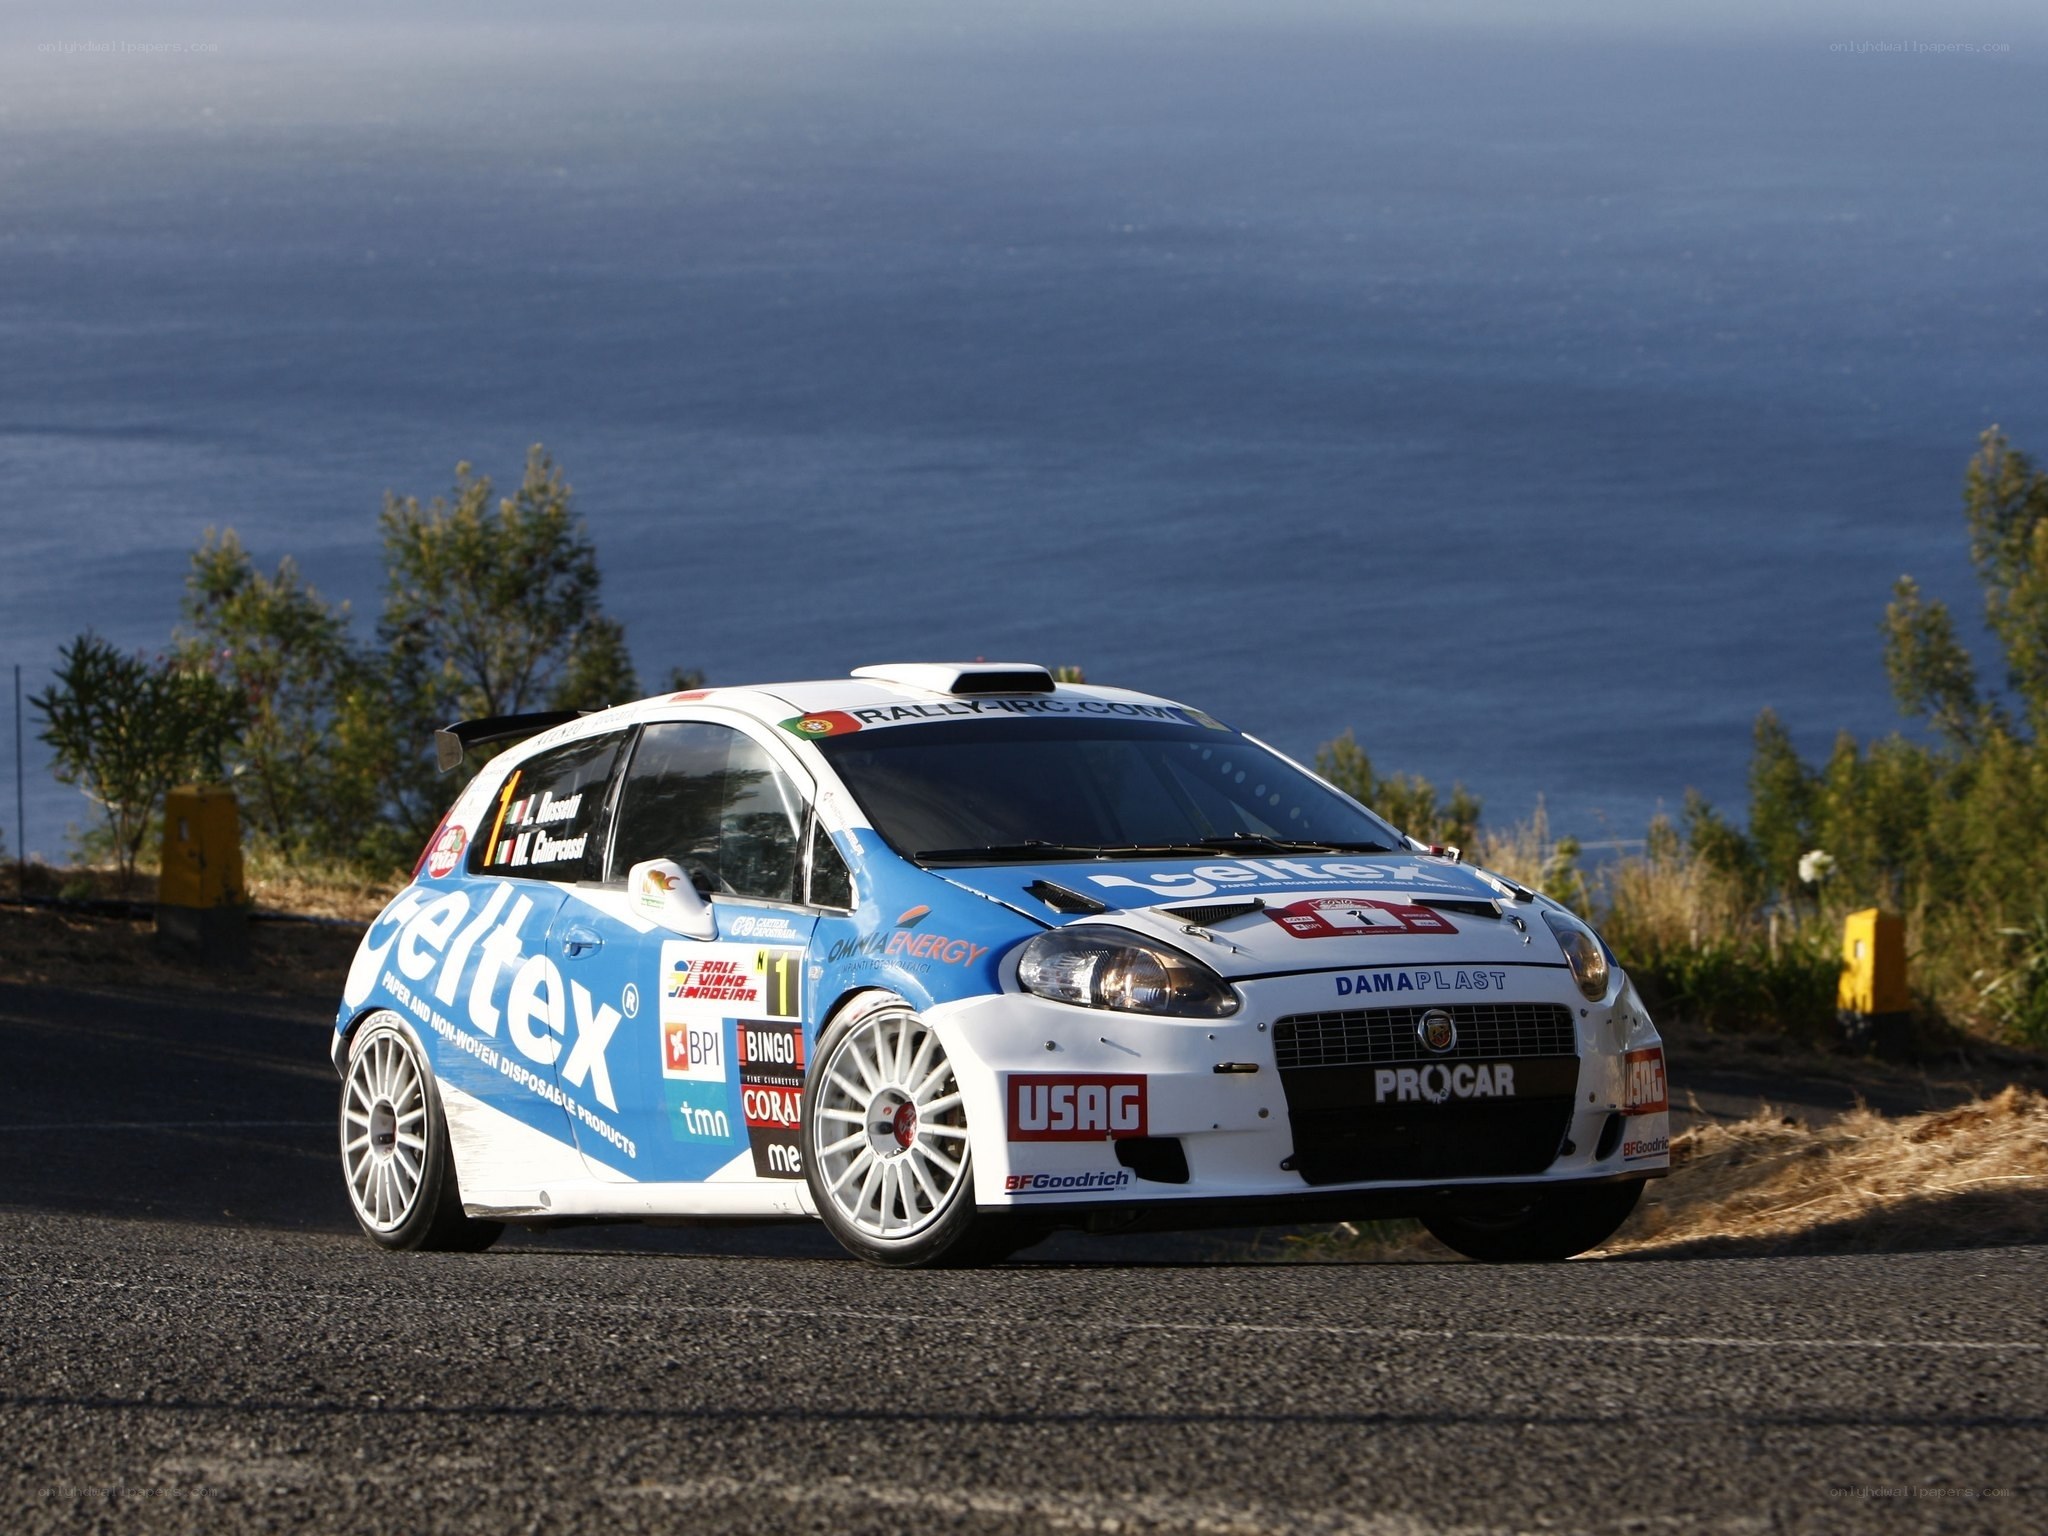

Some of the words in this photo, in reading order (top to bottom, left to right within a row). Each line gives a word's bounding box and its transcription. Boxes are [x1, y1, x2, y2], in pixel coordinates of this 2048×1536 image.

[852, 698, 1178, 725] RALLY-IRC.COM
[484, 770, 522, 867] 1
[511, 832, 530, 867] M.
[885, 930, 989, 967] ENERGY
[775, 951, 788, 1016] 1
[1335, 971, 1506, 996] DAMAPLAST
[382, 971, 411, 1008] PAPER
[410, 997, 430, 1024] AND
[431, 1011, 498, 1070] NON-WOVEN
[500, 1058, 577, 1114] DISPOSABLE
[577, 1107, 637, 1160] PRODUCTS
[688, 1030, 720, 1066] BPI
[746, 1031, 795, 1065] BINGO
[746, 1075, 761, 1084] FINE
[763, 1075, 800, 1087] CIGARETTES
[1374, 1063, 1516, 1103] PROCAR
[680, 1101, 730, 1138] tmn
[1018, 1085, 1140, 1131] USAG
[1005, 1170, 1129, 1190] BFGoodrich
